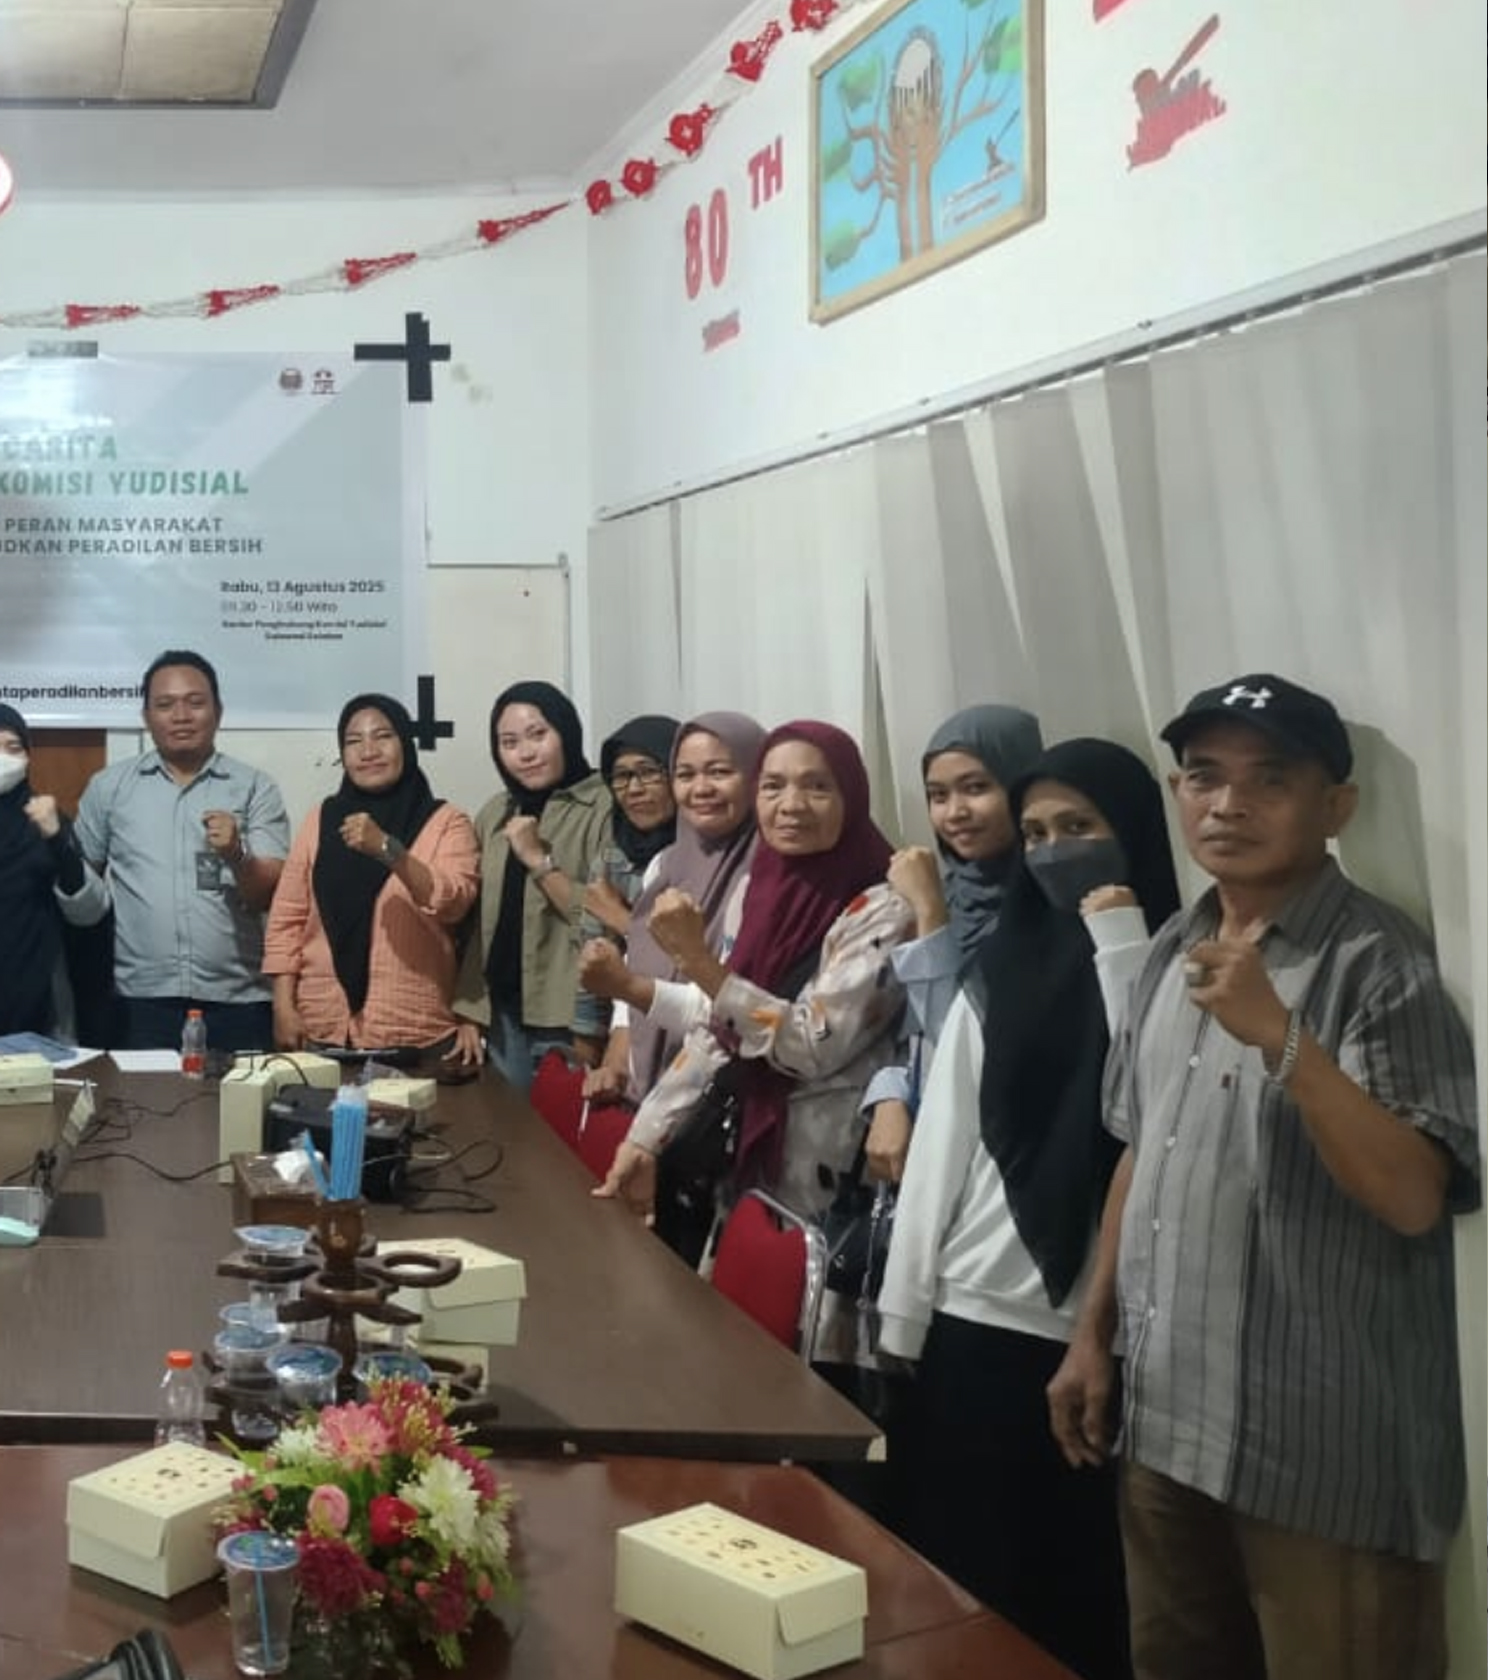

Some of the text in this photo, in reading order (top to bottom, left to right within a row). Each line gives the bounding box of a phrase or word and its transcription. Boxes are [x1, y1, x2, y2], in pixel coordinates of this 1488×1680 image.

[684, 187, 729, 300] 80
[748, 134, 783, 211] TH
[109, 470, 250, 497] YUDISIAL
[5, 516, 72, 534] PERAN
[78, 516, 224, 534] MASYARAKAT
[68, 538, 183, 556] PERADILAN
[189, 538, 264, 556] BERSIH
[220, 580, 264, 595] Rabu,
[284, 580, 346, 596] Agustus
[349, 580, 386, 593] 2025
